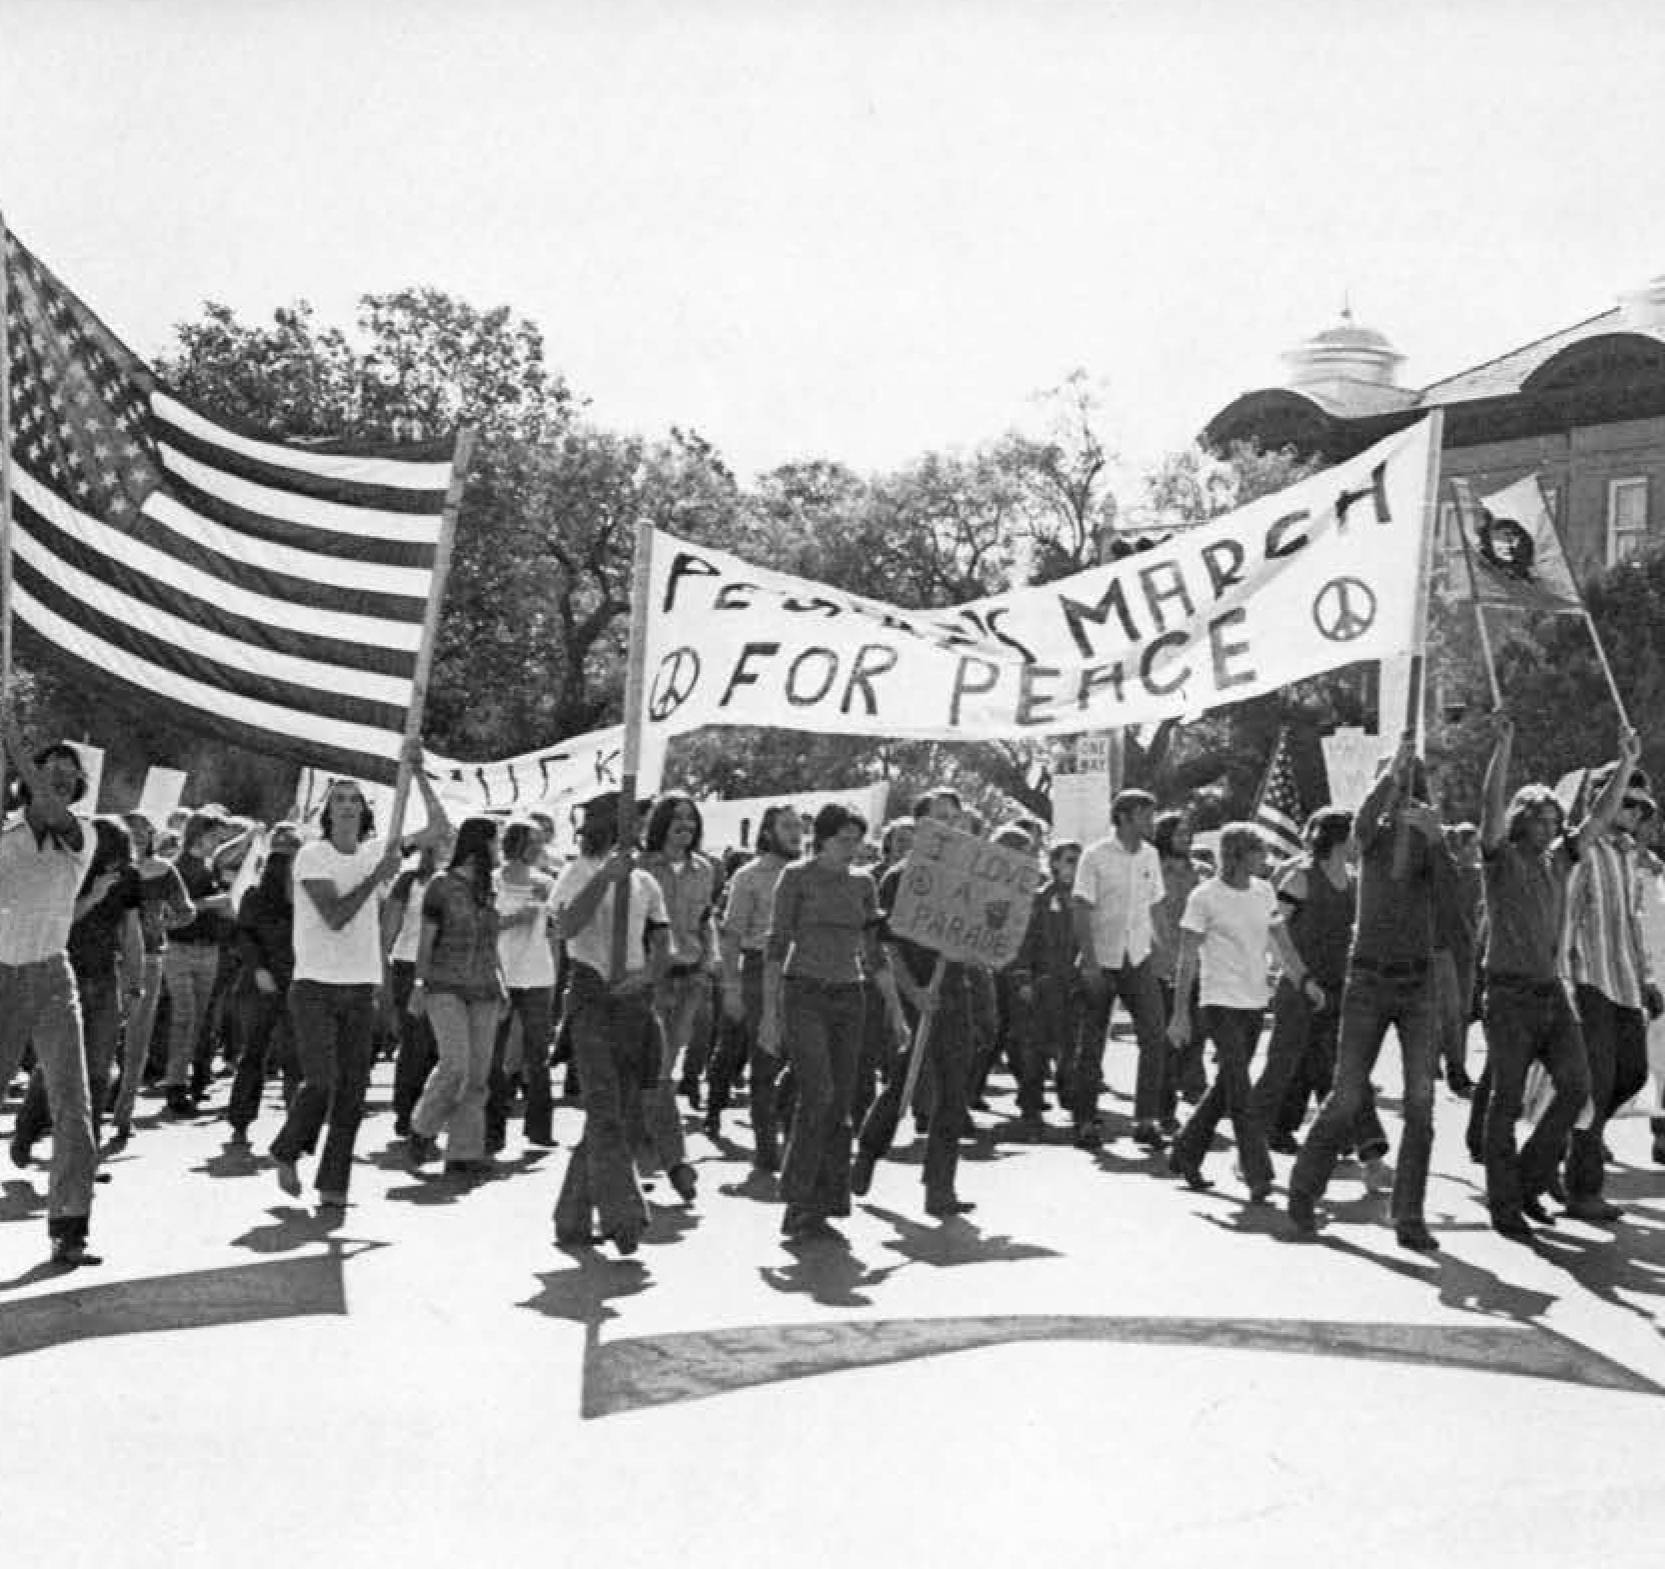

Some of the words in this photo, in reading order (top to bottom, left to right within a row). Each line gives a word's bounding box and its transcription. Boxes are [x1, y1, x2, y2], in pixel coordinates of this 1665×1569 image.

[1058, 460, 1392, 659] MARCH
[719, 641, 898, 716] FOR
[948, 607, 1257, 727] PEACE
[911, 903, 1009, 958] PARADE
